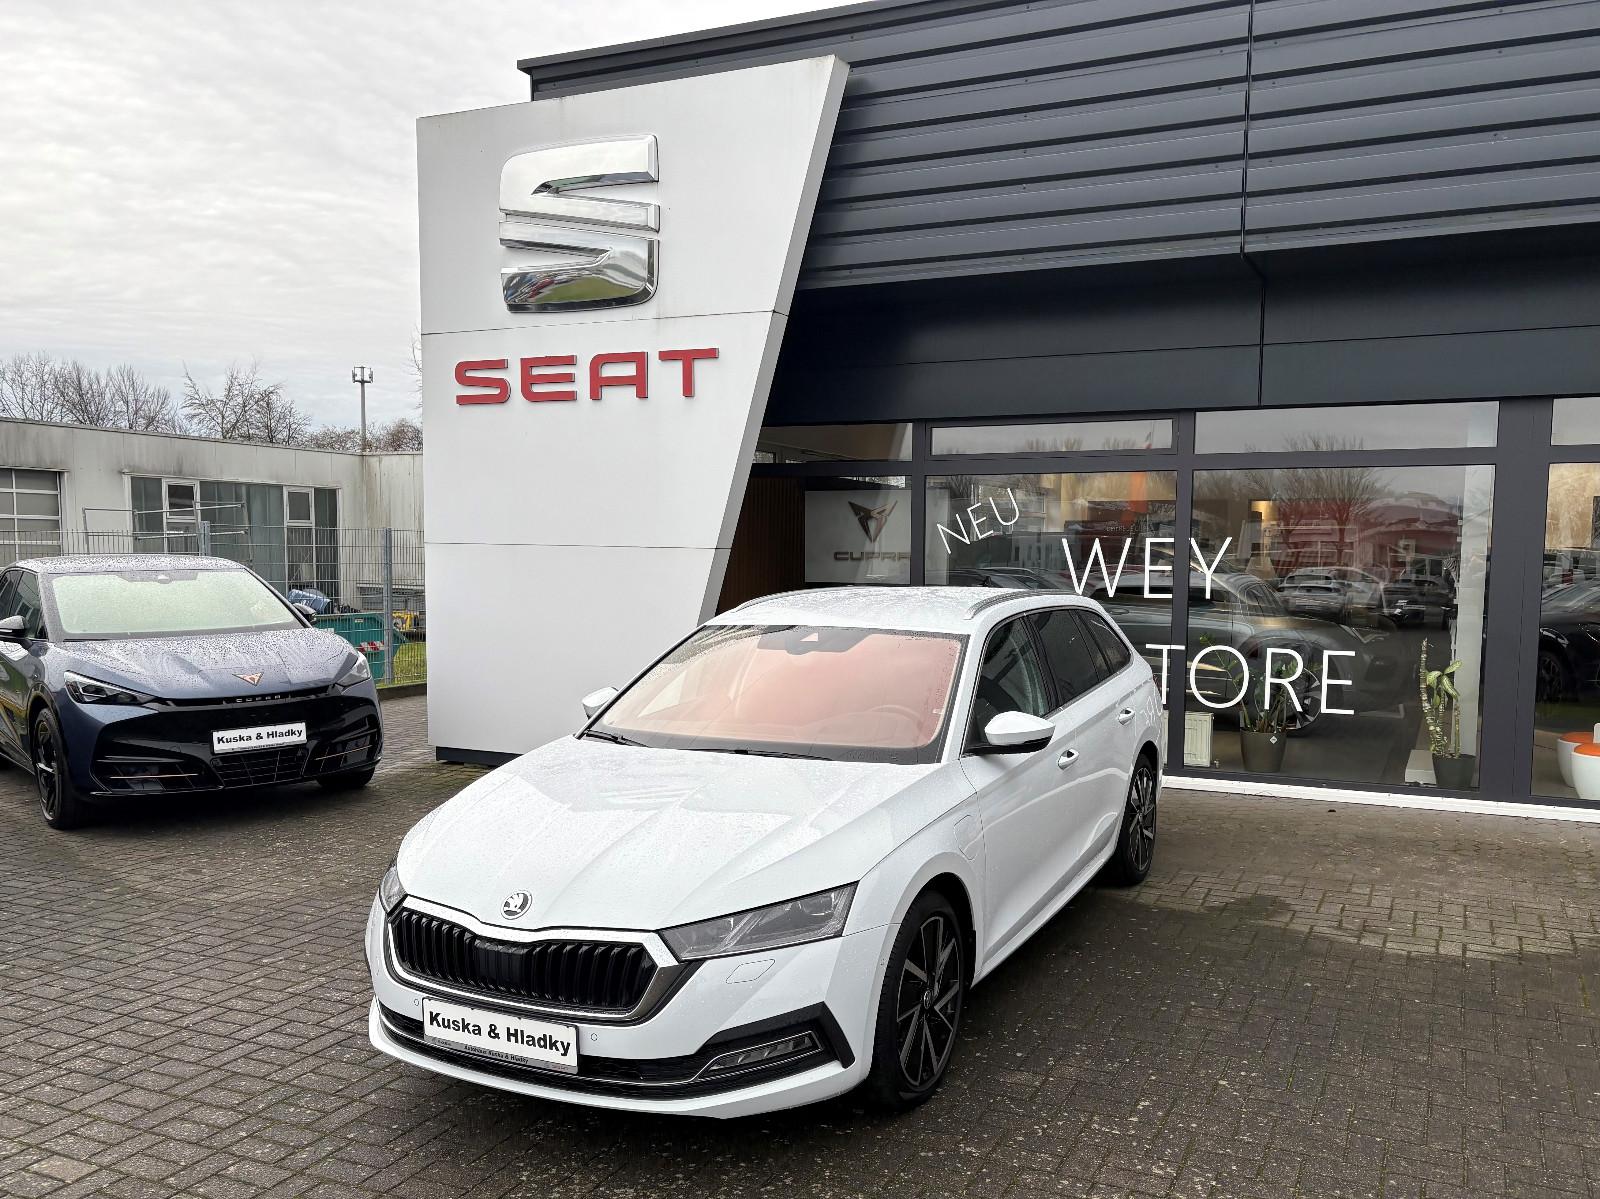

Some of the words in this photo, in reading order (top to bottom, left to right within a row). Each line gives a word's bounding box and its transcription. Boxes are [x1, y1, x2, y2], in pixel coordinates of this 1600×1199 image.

[454, 347, 720, 405] SEAT
[936, 487, 1020, 554] NEU
[1061, 536, 1233, 600] WEY
[1145, 643, 1356, 715] TORE
[217, 734, 252, 744] Kuska
[255, 732, 263, 741] &
[266, 728, 303, 739] Hladky
[429, 1011, 482, 1036] Kuska
[487, 1023, 500, 1040] &
[506, 1027, 571, 1057] Hladky
